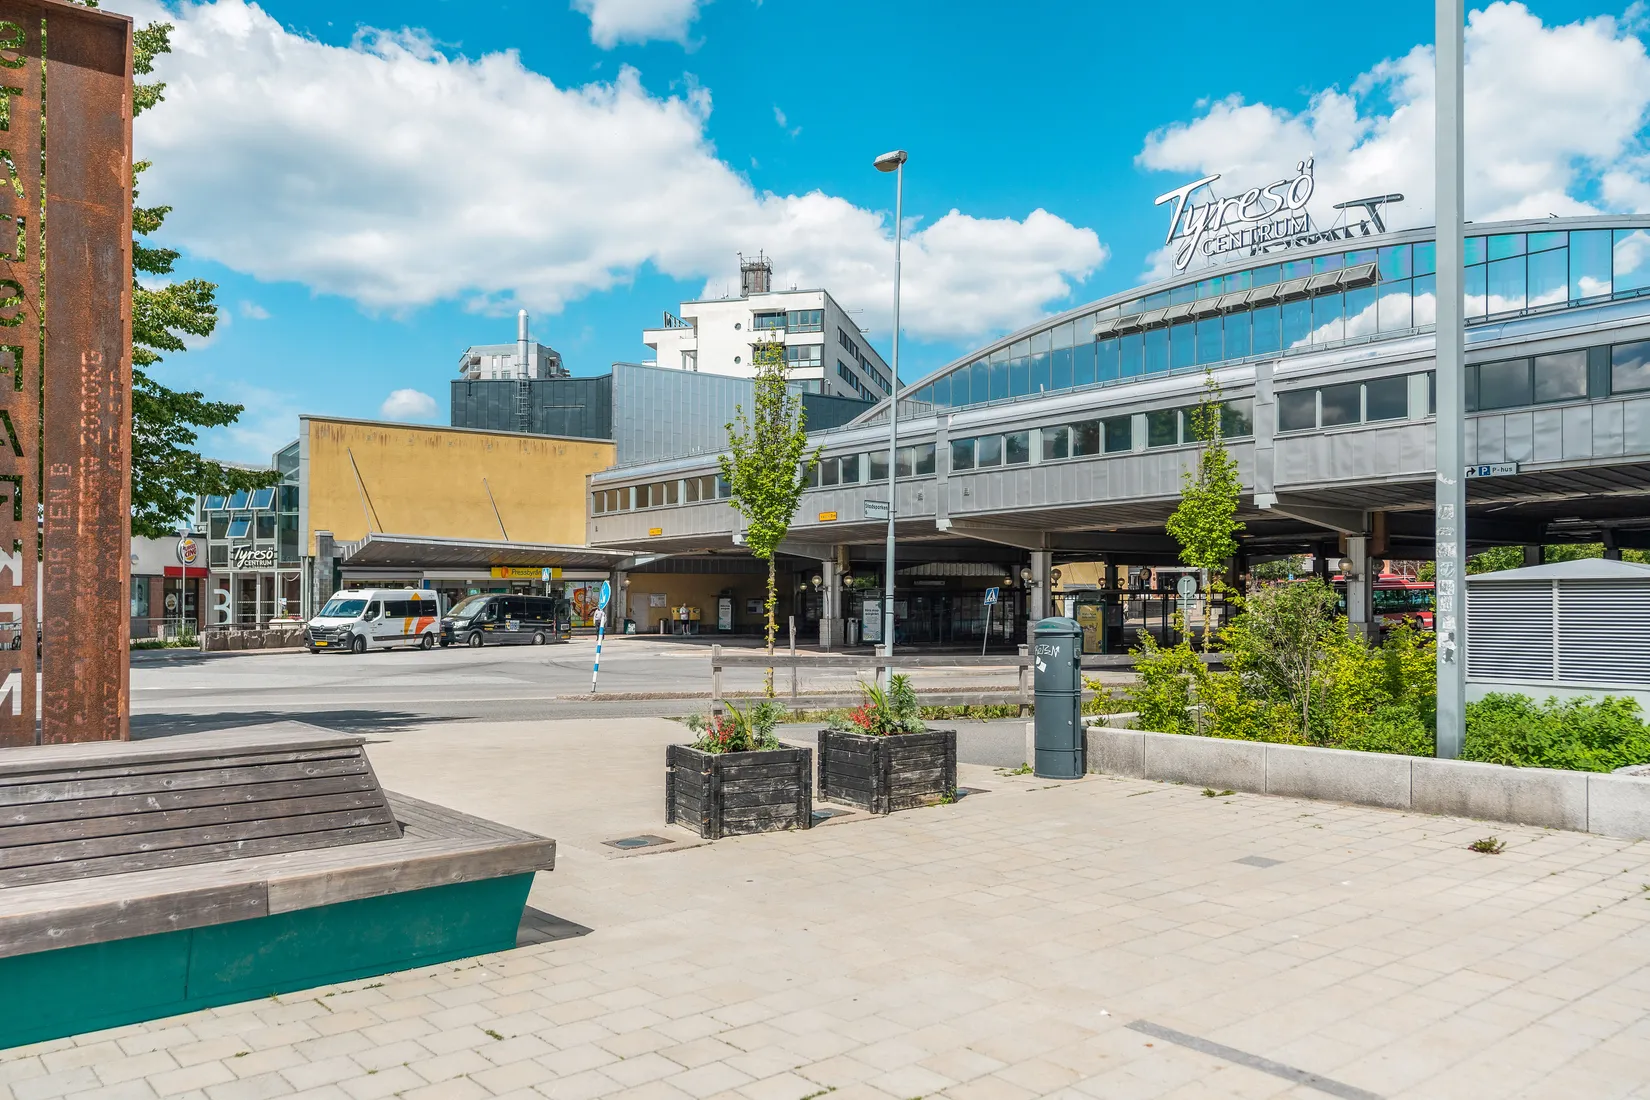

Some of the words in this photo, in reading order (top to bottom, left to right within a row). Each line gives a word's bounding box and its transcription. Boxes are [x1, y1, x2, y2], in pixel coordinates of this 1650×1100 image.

[1154, 158, 1315, 271] Tyresö
[1201, 212, 1310, 257] CENTRUM
[47, 489, 72, 535] TEN
[233, 544, 274, 569] Tyresö
